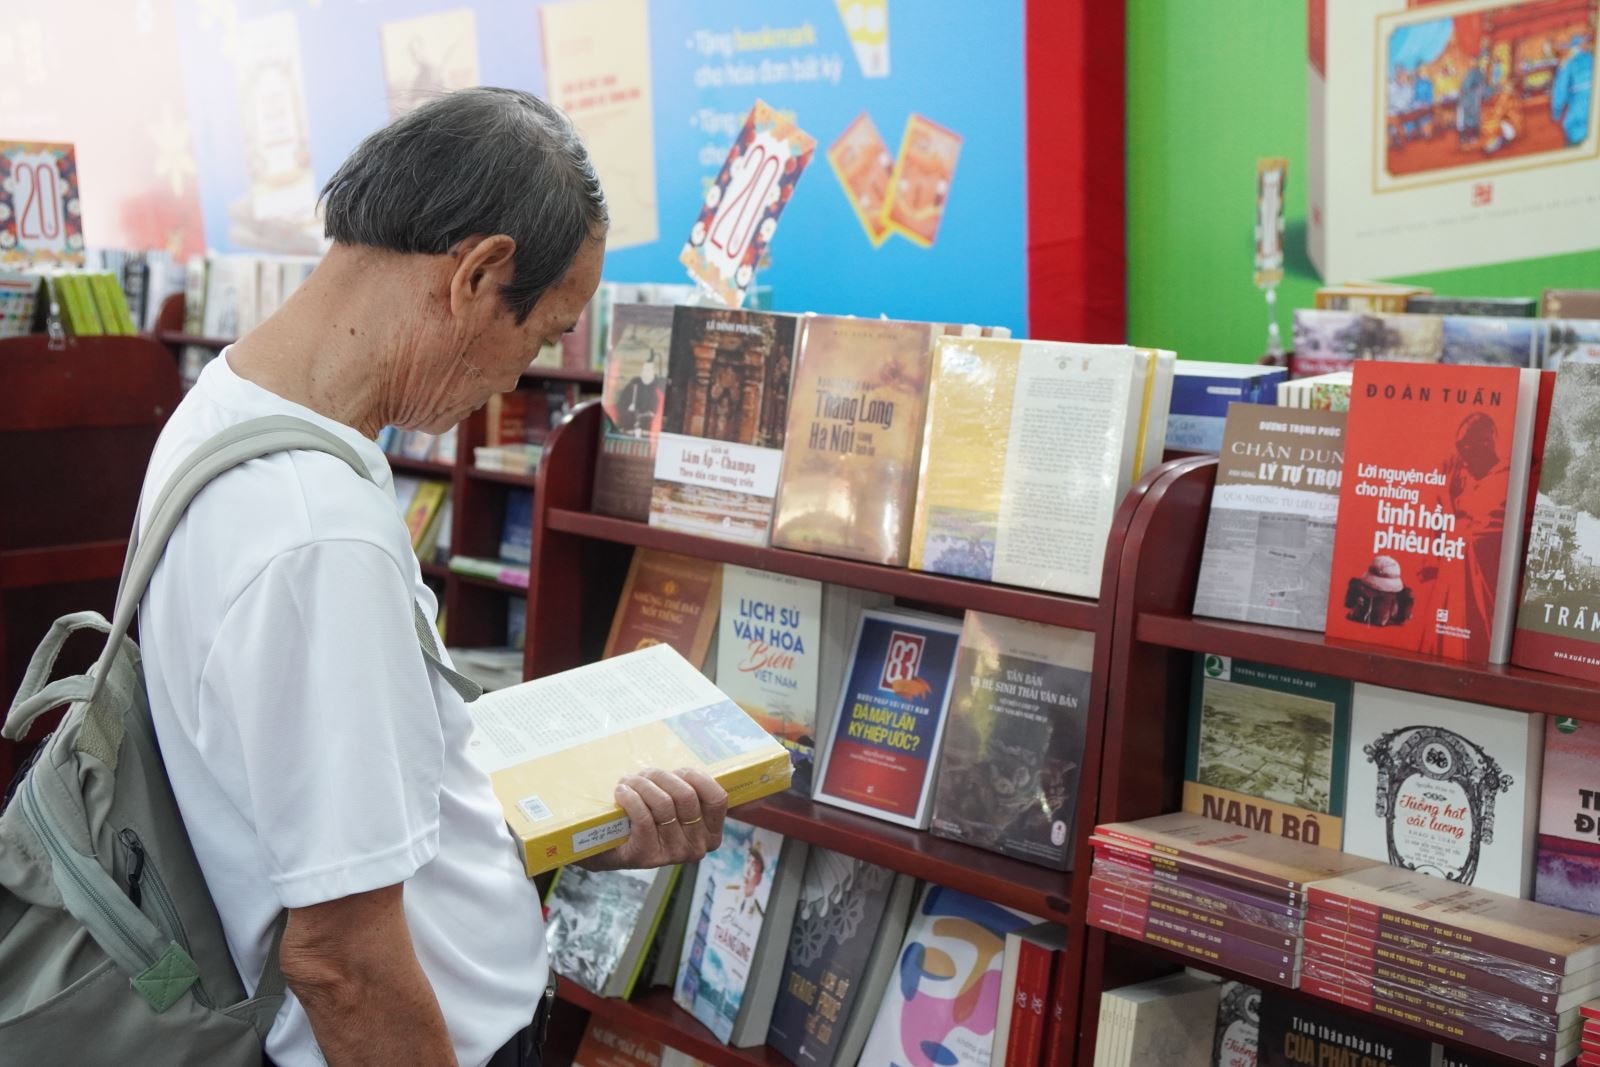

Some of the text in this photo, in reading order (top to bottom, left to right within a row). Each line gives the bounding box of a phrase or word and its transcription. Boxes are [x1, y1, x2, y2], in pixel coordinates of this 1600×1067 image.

[16, 162, 59, 240] 20
[710, 144, 779, 260] 20
[1366, 383, 1431, 401] ĐOÀN
[859, 394, 895, 430] Long
[1231, 441, 1291, 460] CHÂN
[1258, 460, 1278, 481] LÝ
[1358, 463, 1377, 478] Lời
[1379, 467, 1424, 485] nguyện
[1355, 480, 1419, 504] cho những
[1377, 499, 1456, 532] linh hồn
[1373, 526, 1466, 562] phiêu dạt
[1201, 793, 1273, 834] NAM
[1574, 812, 1600, 840] Đ
